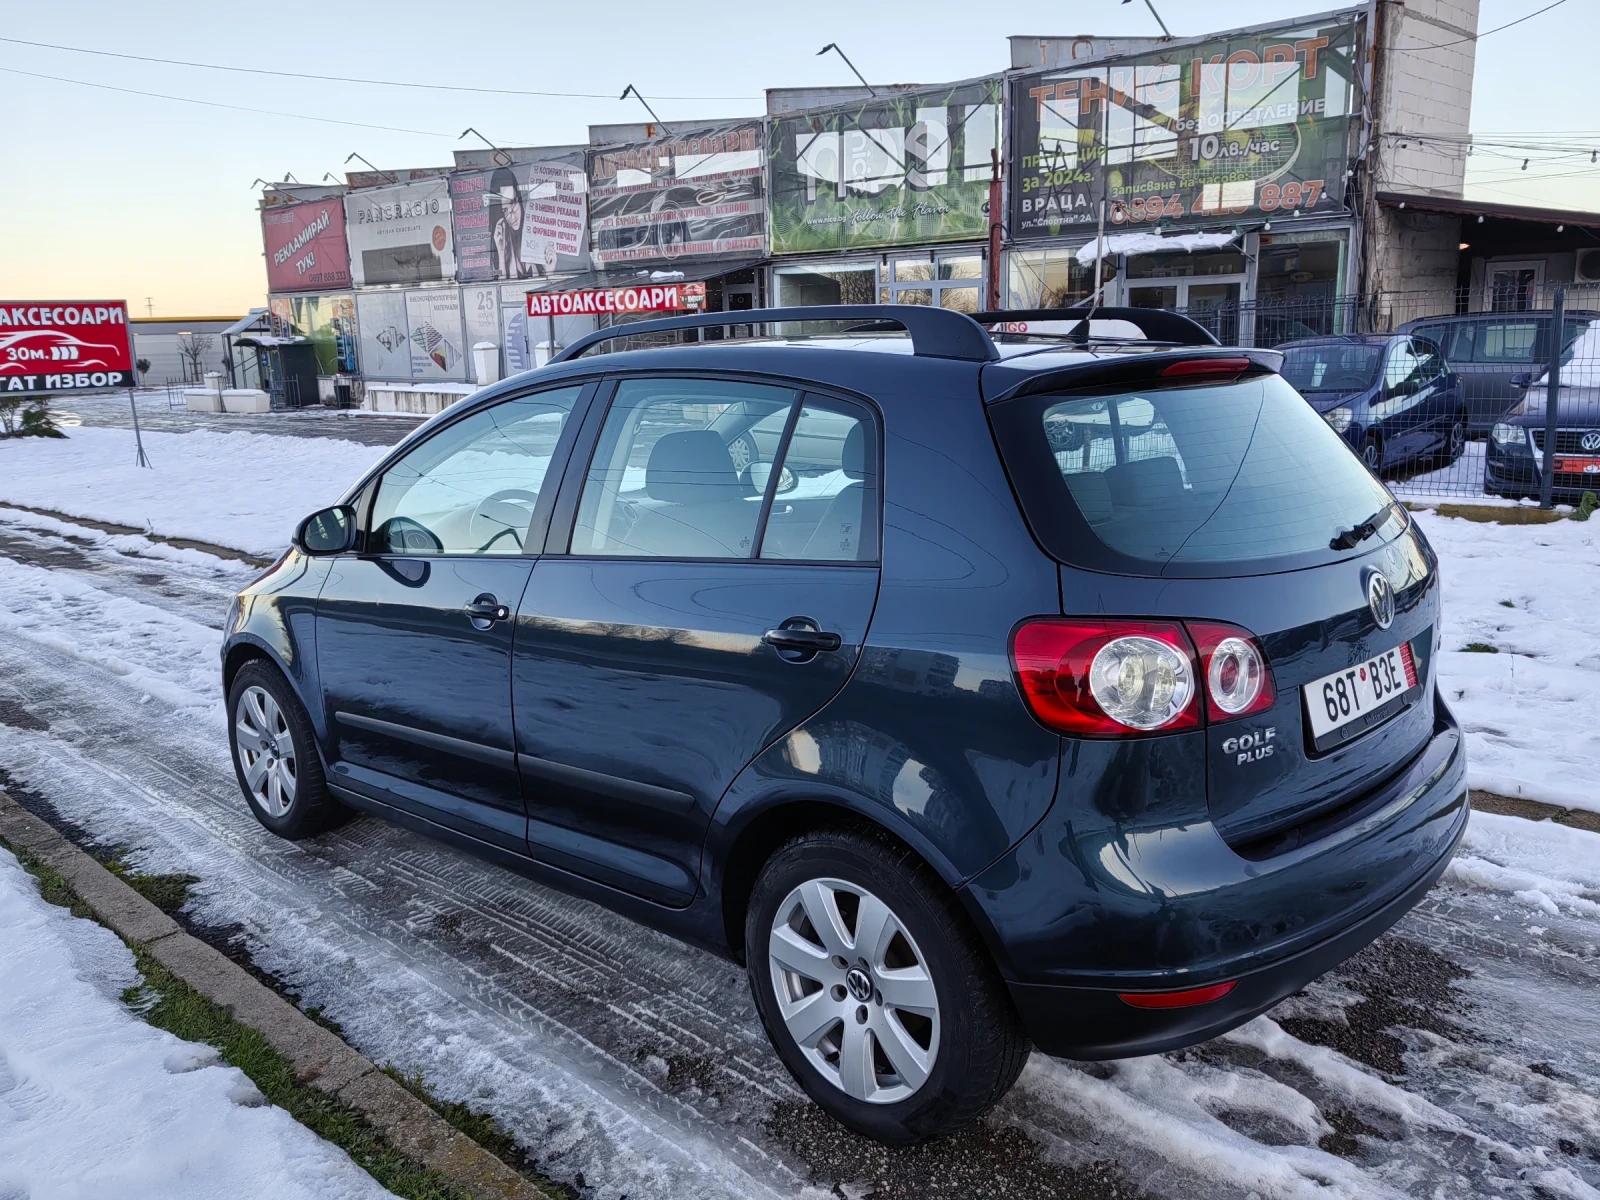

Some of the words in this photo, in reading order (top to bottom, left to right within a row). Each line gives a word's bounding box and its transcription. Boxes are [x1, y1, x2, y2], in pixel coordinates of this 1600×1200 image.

[1029, 62, 1178, 122] ТЕНИС
[1190, 36, 1329, 97] КОРТ
[1207, 99, 1325, 127] ОСВЕТЛЕНИЕ
[1022, 145, 1106, 168] ПРЦИЯ
[1044, 168, 1095, 187] 2024г.
[1112, 181, 1176, 198] записване
[1180, 177, 1195, 189] на
[1197, 171, 1250, 185] часове:
[357, 199, 440, 224] PANCRACIO
[850, 208, 883, 225] Follow
[886, 205, 907, 219] the
[912, 202, 952, 219] Flavor
[1022, 193, 1093, 212] ВРАЦА,
[1110, 194, 1184, 224] 0894
[1260, 180, 1324, 211] 887
[806, 215, 847, 226] www.nice.bg
[274, 209, 330, 267] РЕКЛАМИРАЙ
[296, 252, 316, 275] ТУК!
[477, 291, 494, 310] 25
[530, 287, 678, 314] АВТОАКСЕСОАРИ
[45, 372, 123, 389] ИЗБОР
[1322, 670, 1361, 723] 68T
[1222, 727, 1276, 755] GOLF
[1236, 745, 1274, 766] PLUS
